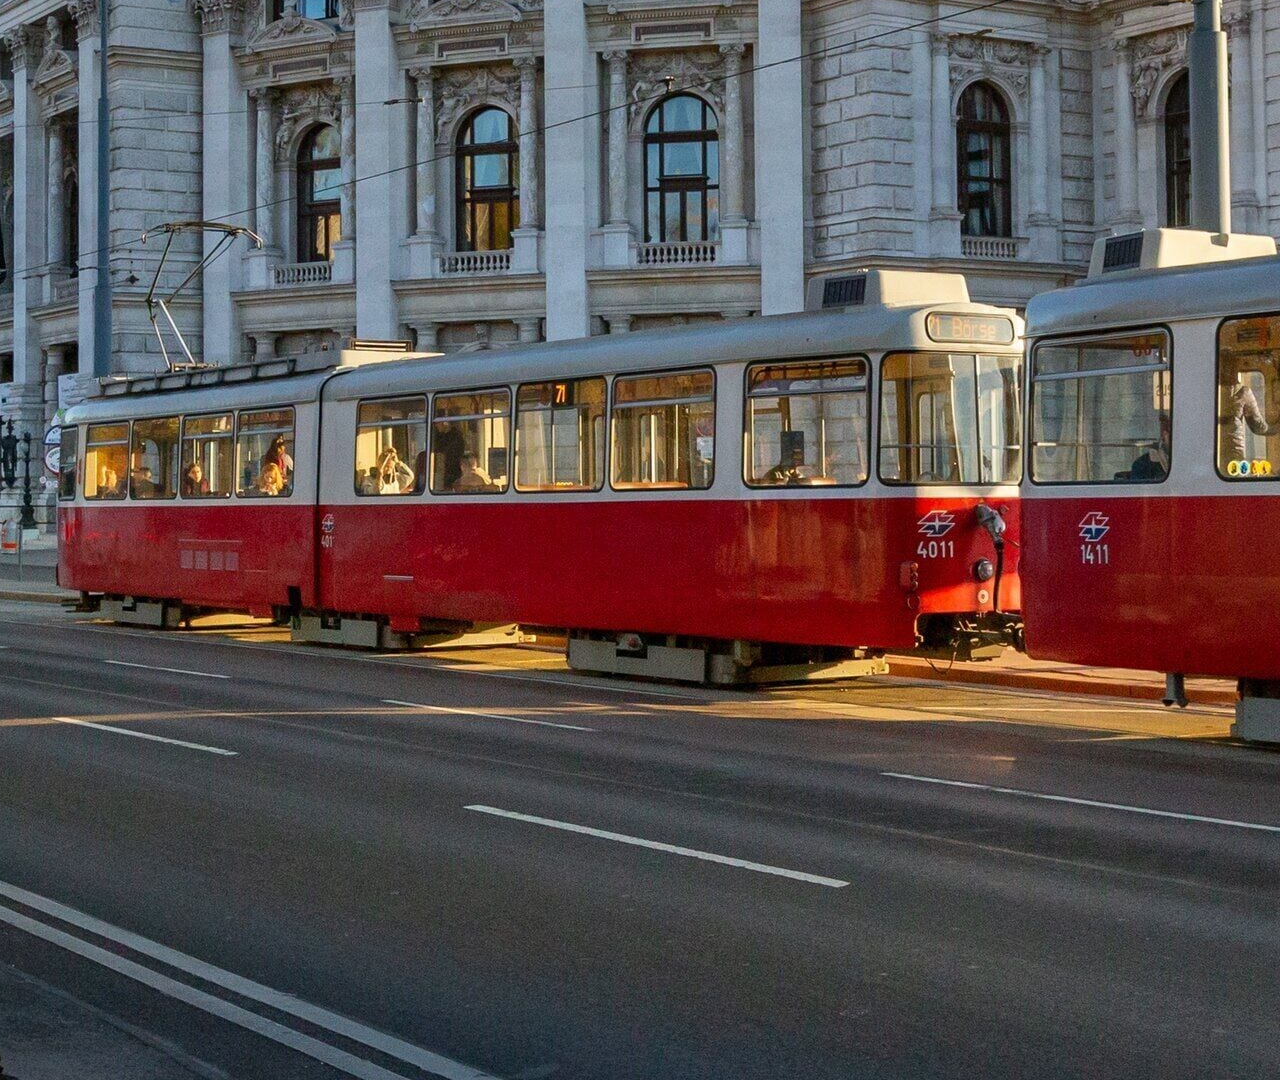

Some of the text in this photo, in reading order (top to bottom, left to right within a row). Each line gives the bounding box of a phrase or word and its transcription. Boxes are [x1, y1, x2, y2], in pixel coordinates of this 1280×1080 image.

[951, 317, 997, 337] Börse
[555, 384, 566, 403] 71
[321, 535, 335, 548] 401
[917, 541, 955, 559] 4011
[1080, 544, 1109, 565] 1411
